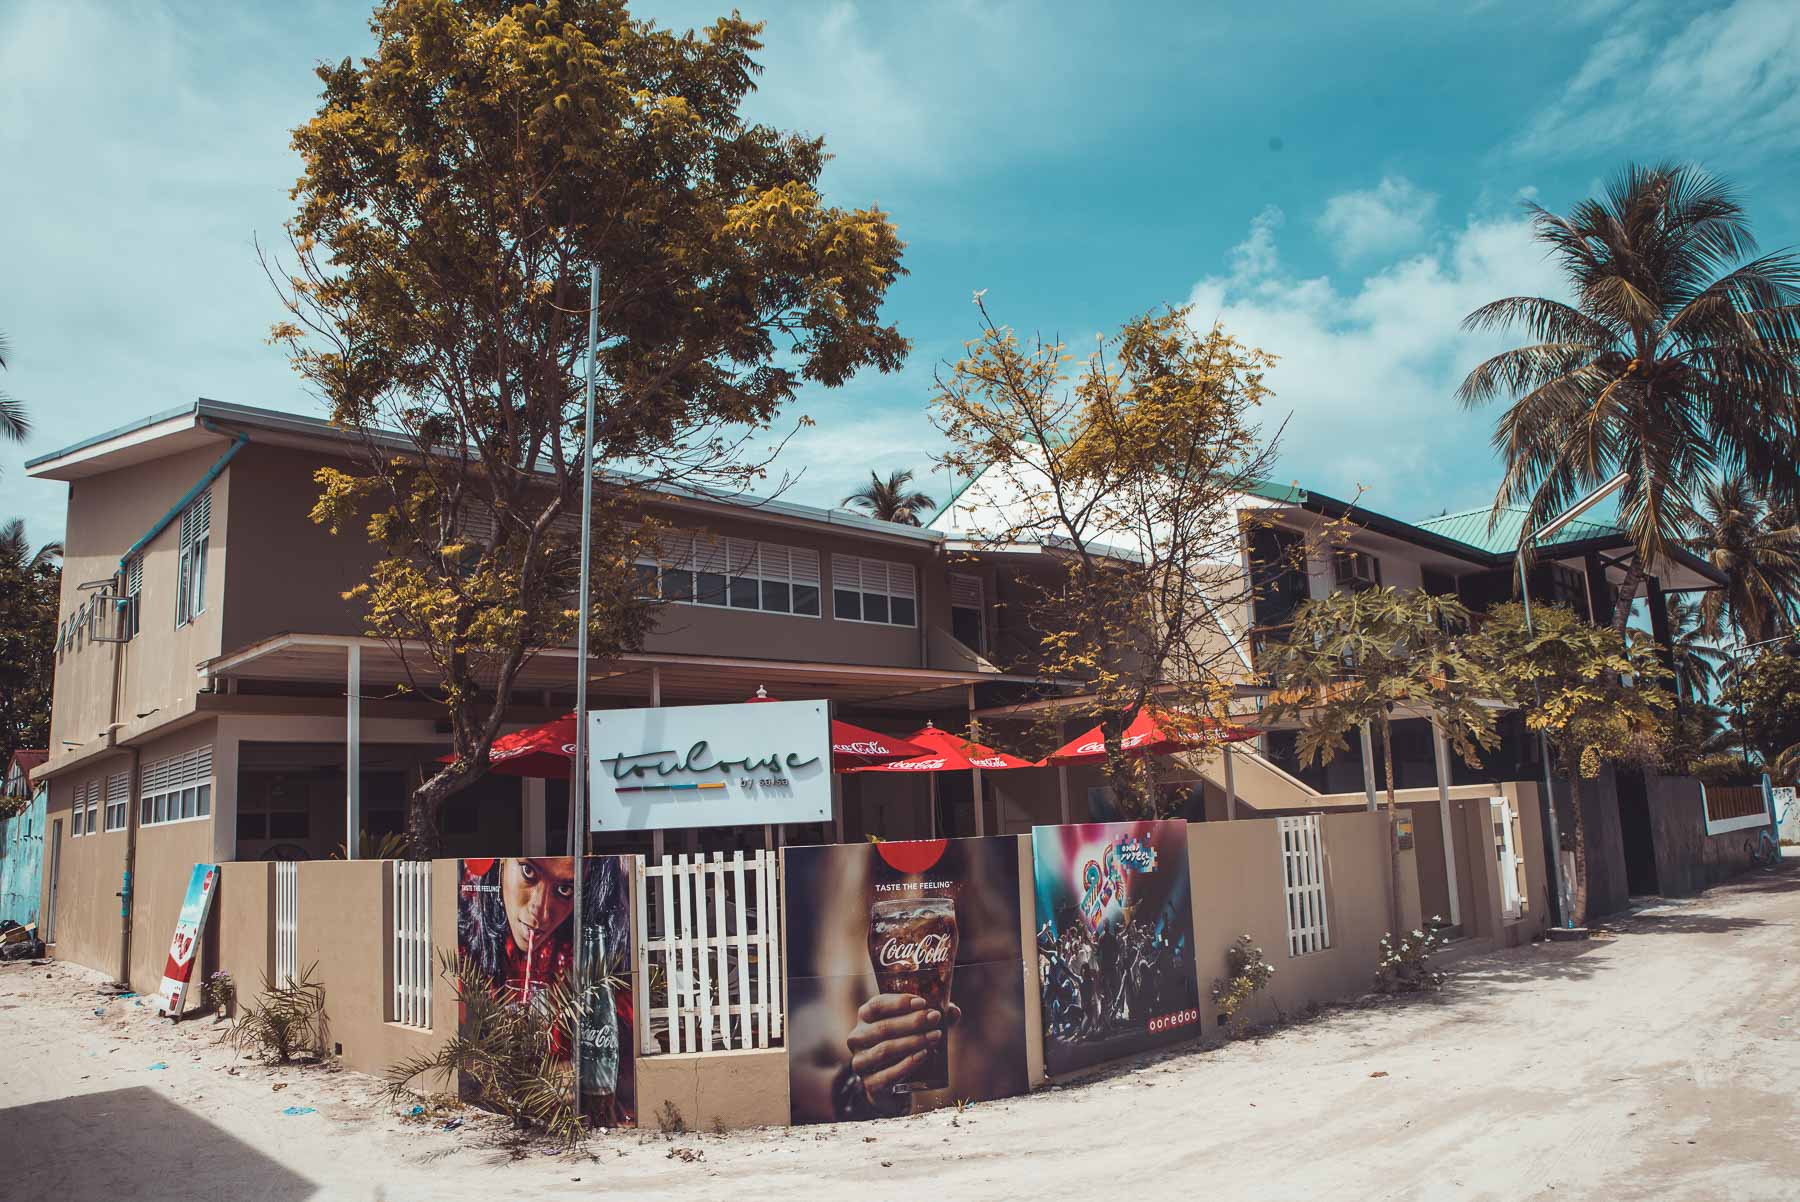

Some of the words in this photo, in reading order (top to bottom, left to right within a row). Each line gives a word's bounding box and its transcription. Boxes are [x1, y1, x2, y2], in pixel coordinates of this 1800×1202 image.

[600, 740, 819, 780] toulouse
[740, 777, 754, 790] by
[875, 883, 901, 892] TASTE
[902, 882, 918, 891] THE
[880, 933, 951, 972] Coca-Cola
[1149, 1010, 1197, 1031] ooredoo
